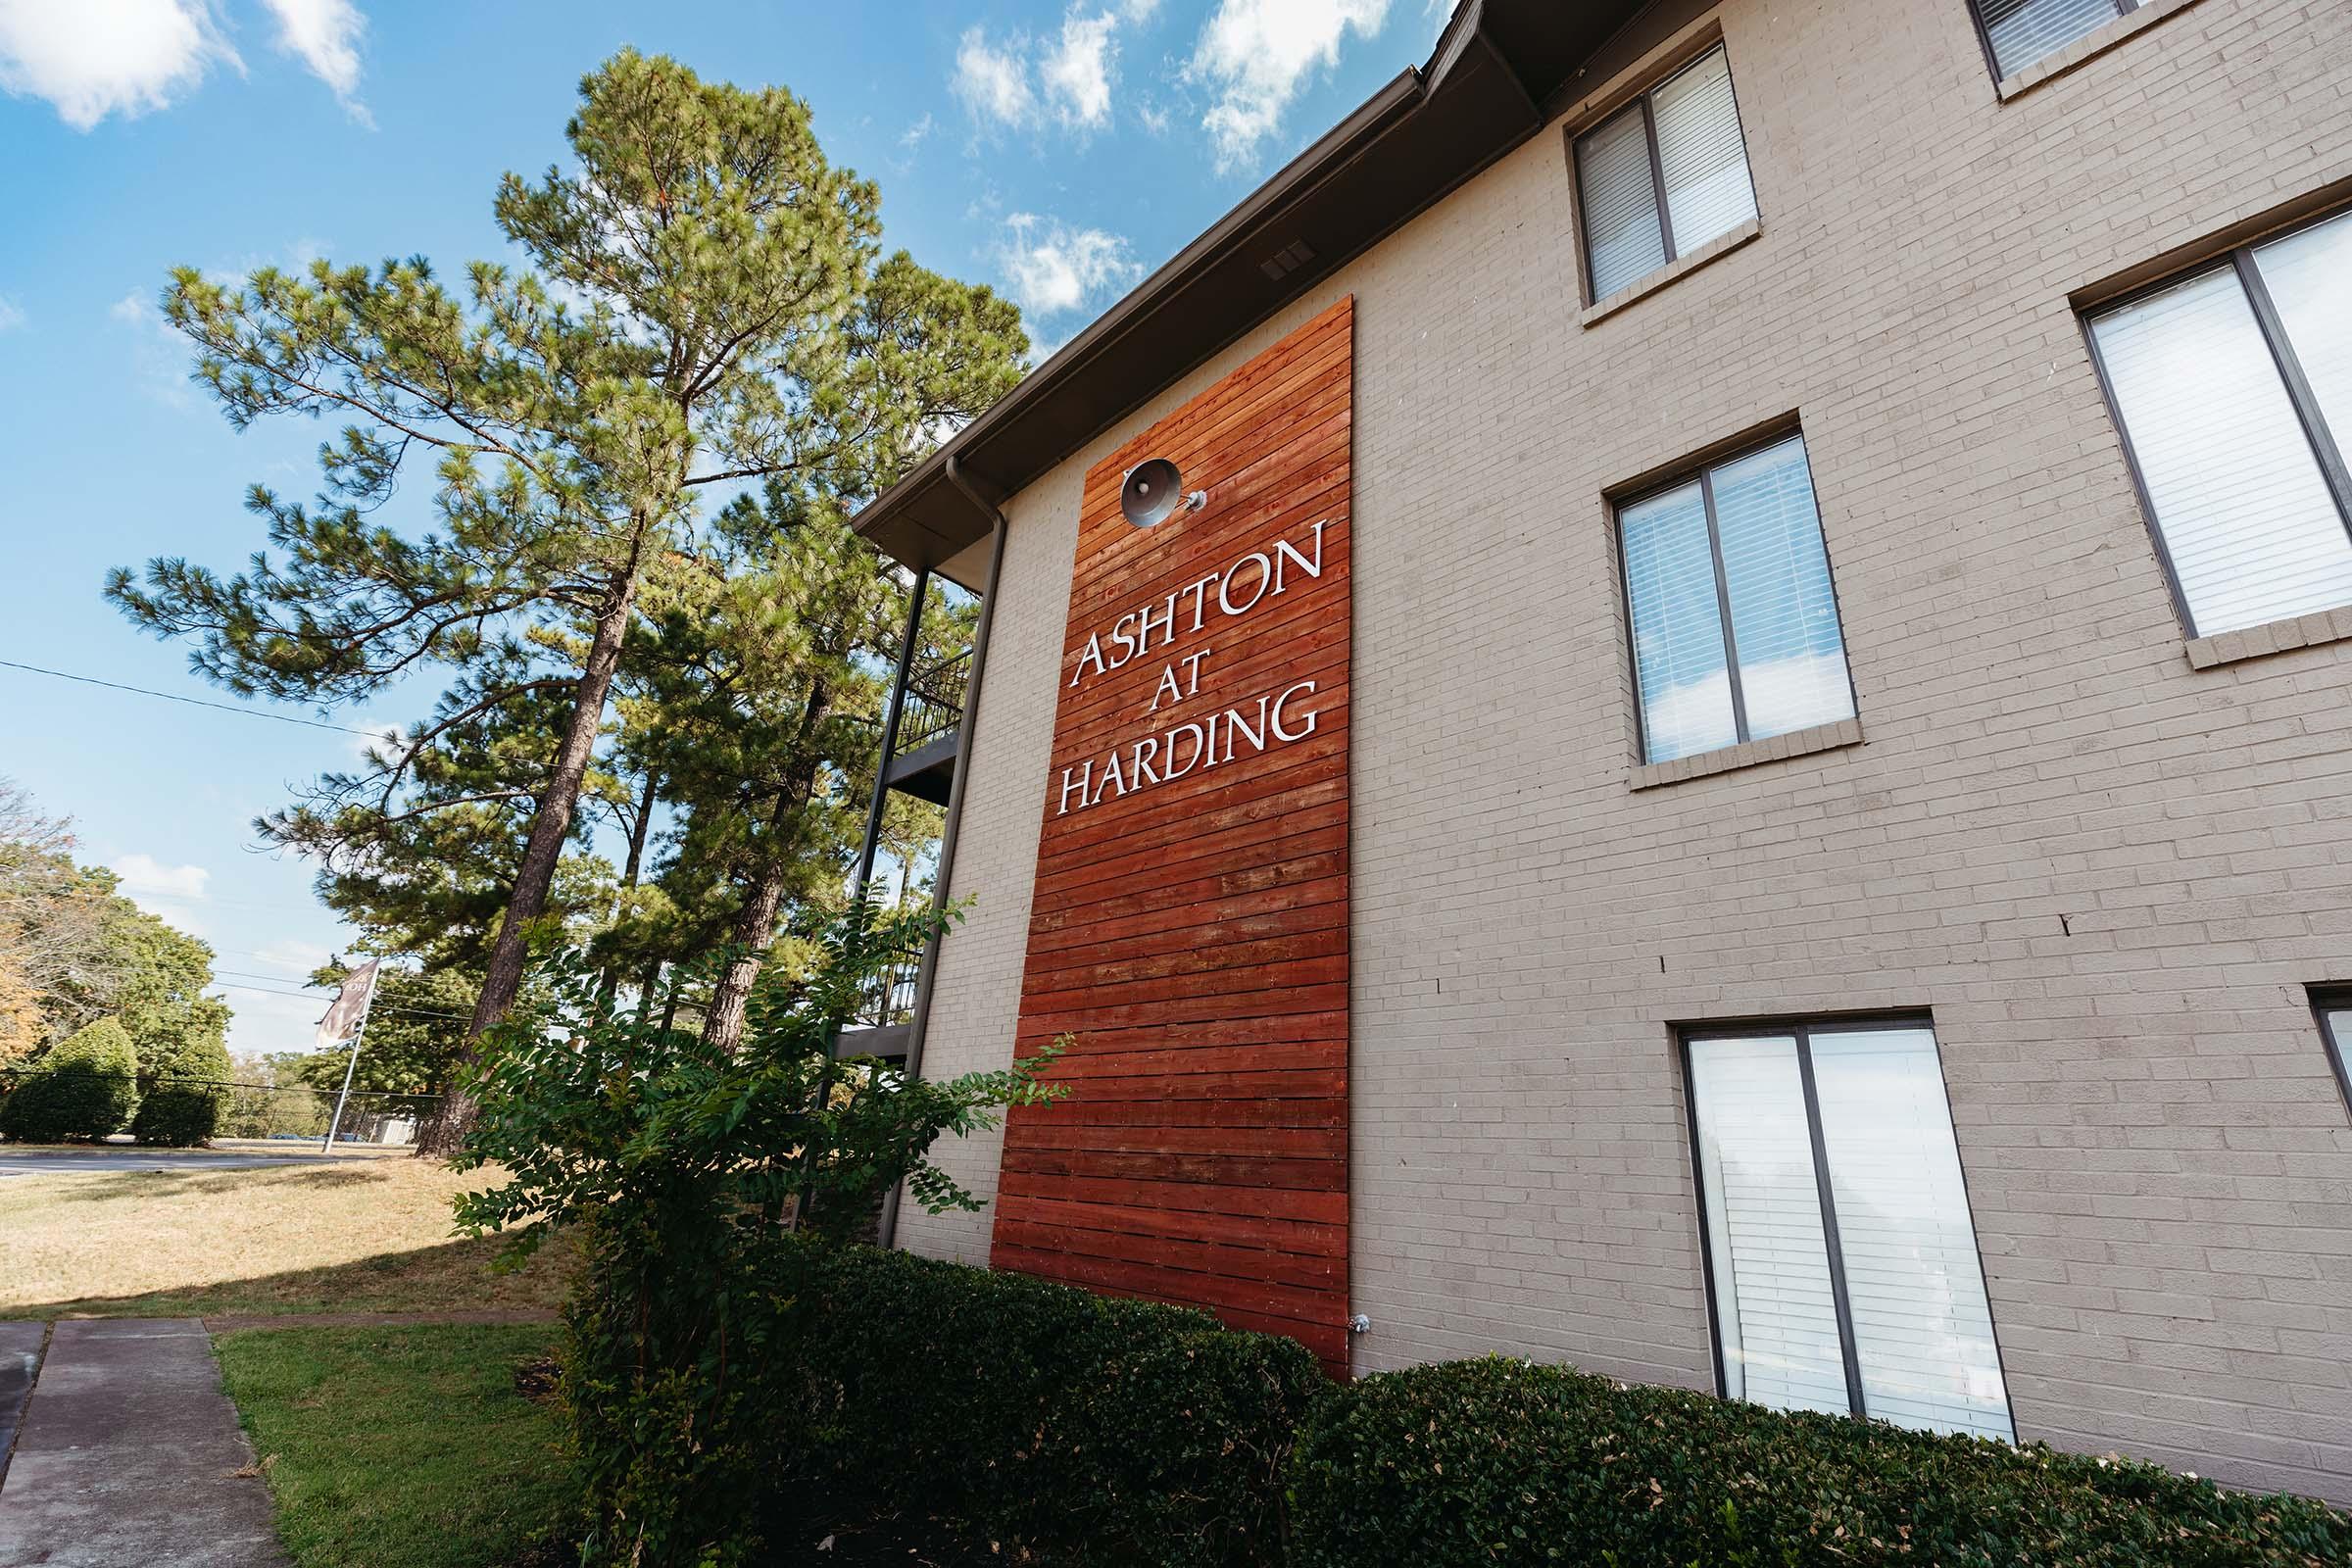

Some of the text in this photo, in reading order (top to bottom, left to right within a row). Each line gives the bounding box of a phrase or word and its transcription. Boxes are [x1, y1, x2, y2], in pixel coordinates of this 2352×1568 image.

[1069, 518, 1327, 688] ASHTON
[1149, 648, 1210, 711] AT
[1056, 681, 1318, 815] HARDING
